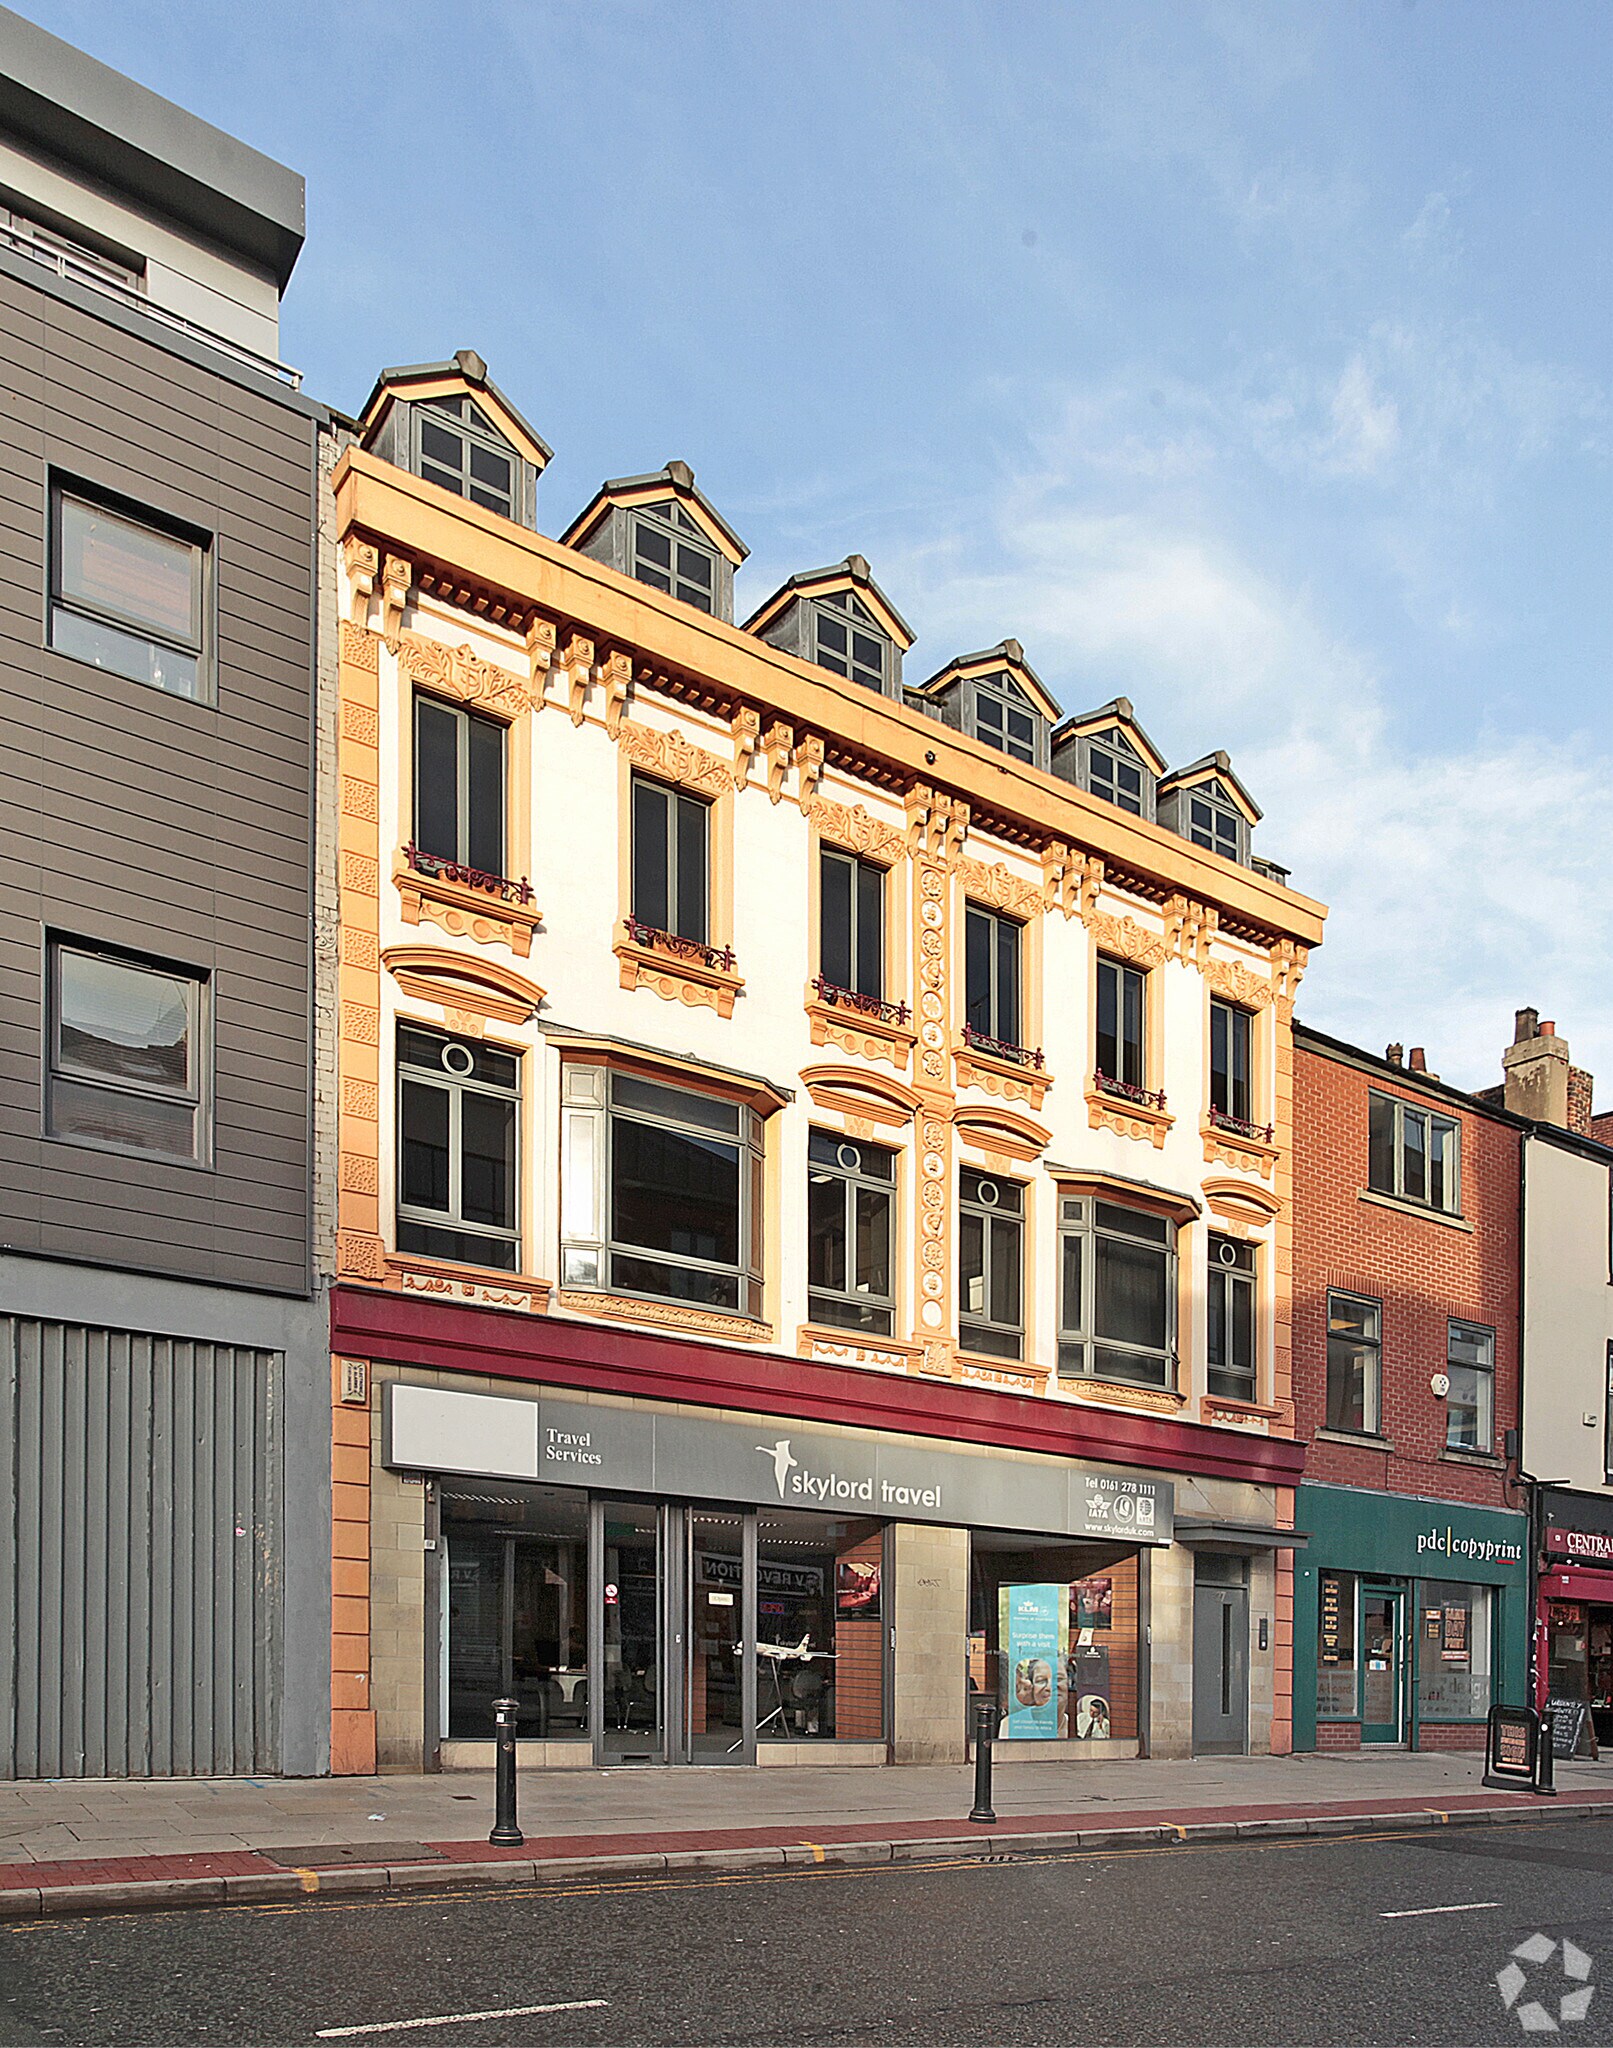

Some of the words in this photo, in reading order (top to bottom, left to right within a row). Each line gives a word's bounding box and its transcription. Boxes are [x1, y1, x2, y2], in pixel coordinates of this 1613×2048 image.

[546, 1428, 591, 1447] Travel
[546, 1446, 602, 1465] Services
[792, 1470, 873, 1501] skylord
[881, 1480, 941, 1508] travel
[1084, 1477, 1098, 1488] Tel
[1100, 1479, 1118, 1491] 0161
[1121, 1482, 1137, 1493] 278
[1139, 1484, 1155, 1495] 1111
[1088, 1508, 1108, 1519] IATA
[1084, 1523, 1154, 1537] www.skylorduk.com
[1452, 1538, 1521, 1561] copyprint
[1012, 1632, 1037, 1640] Surprise
